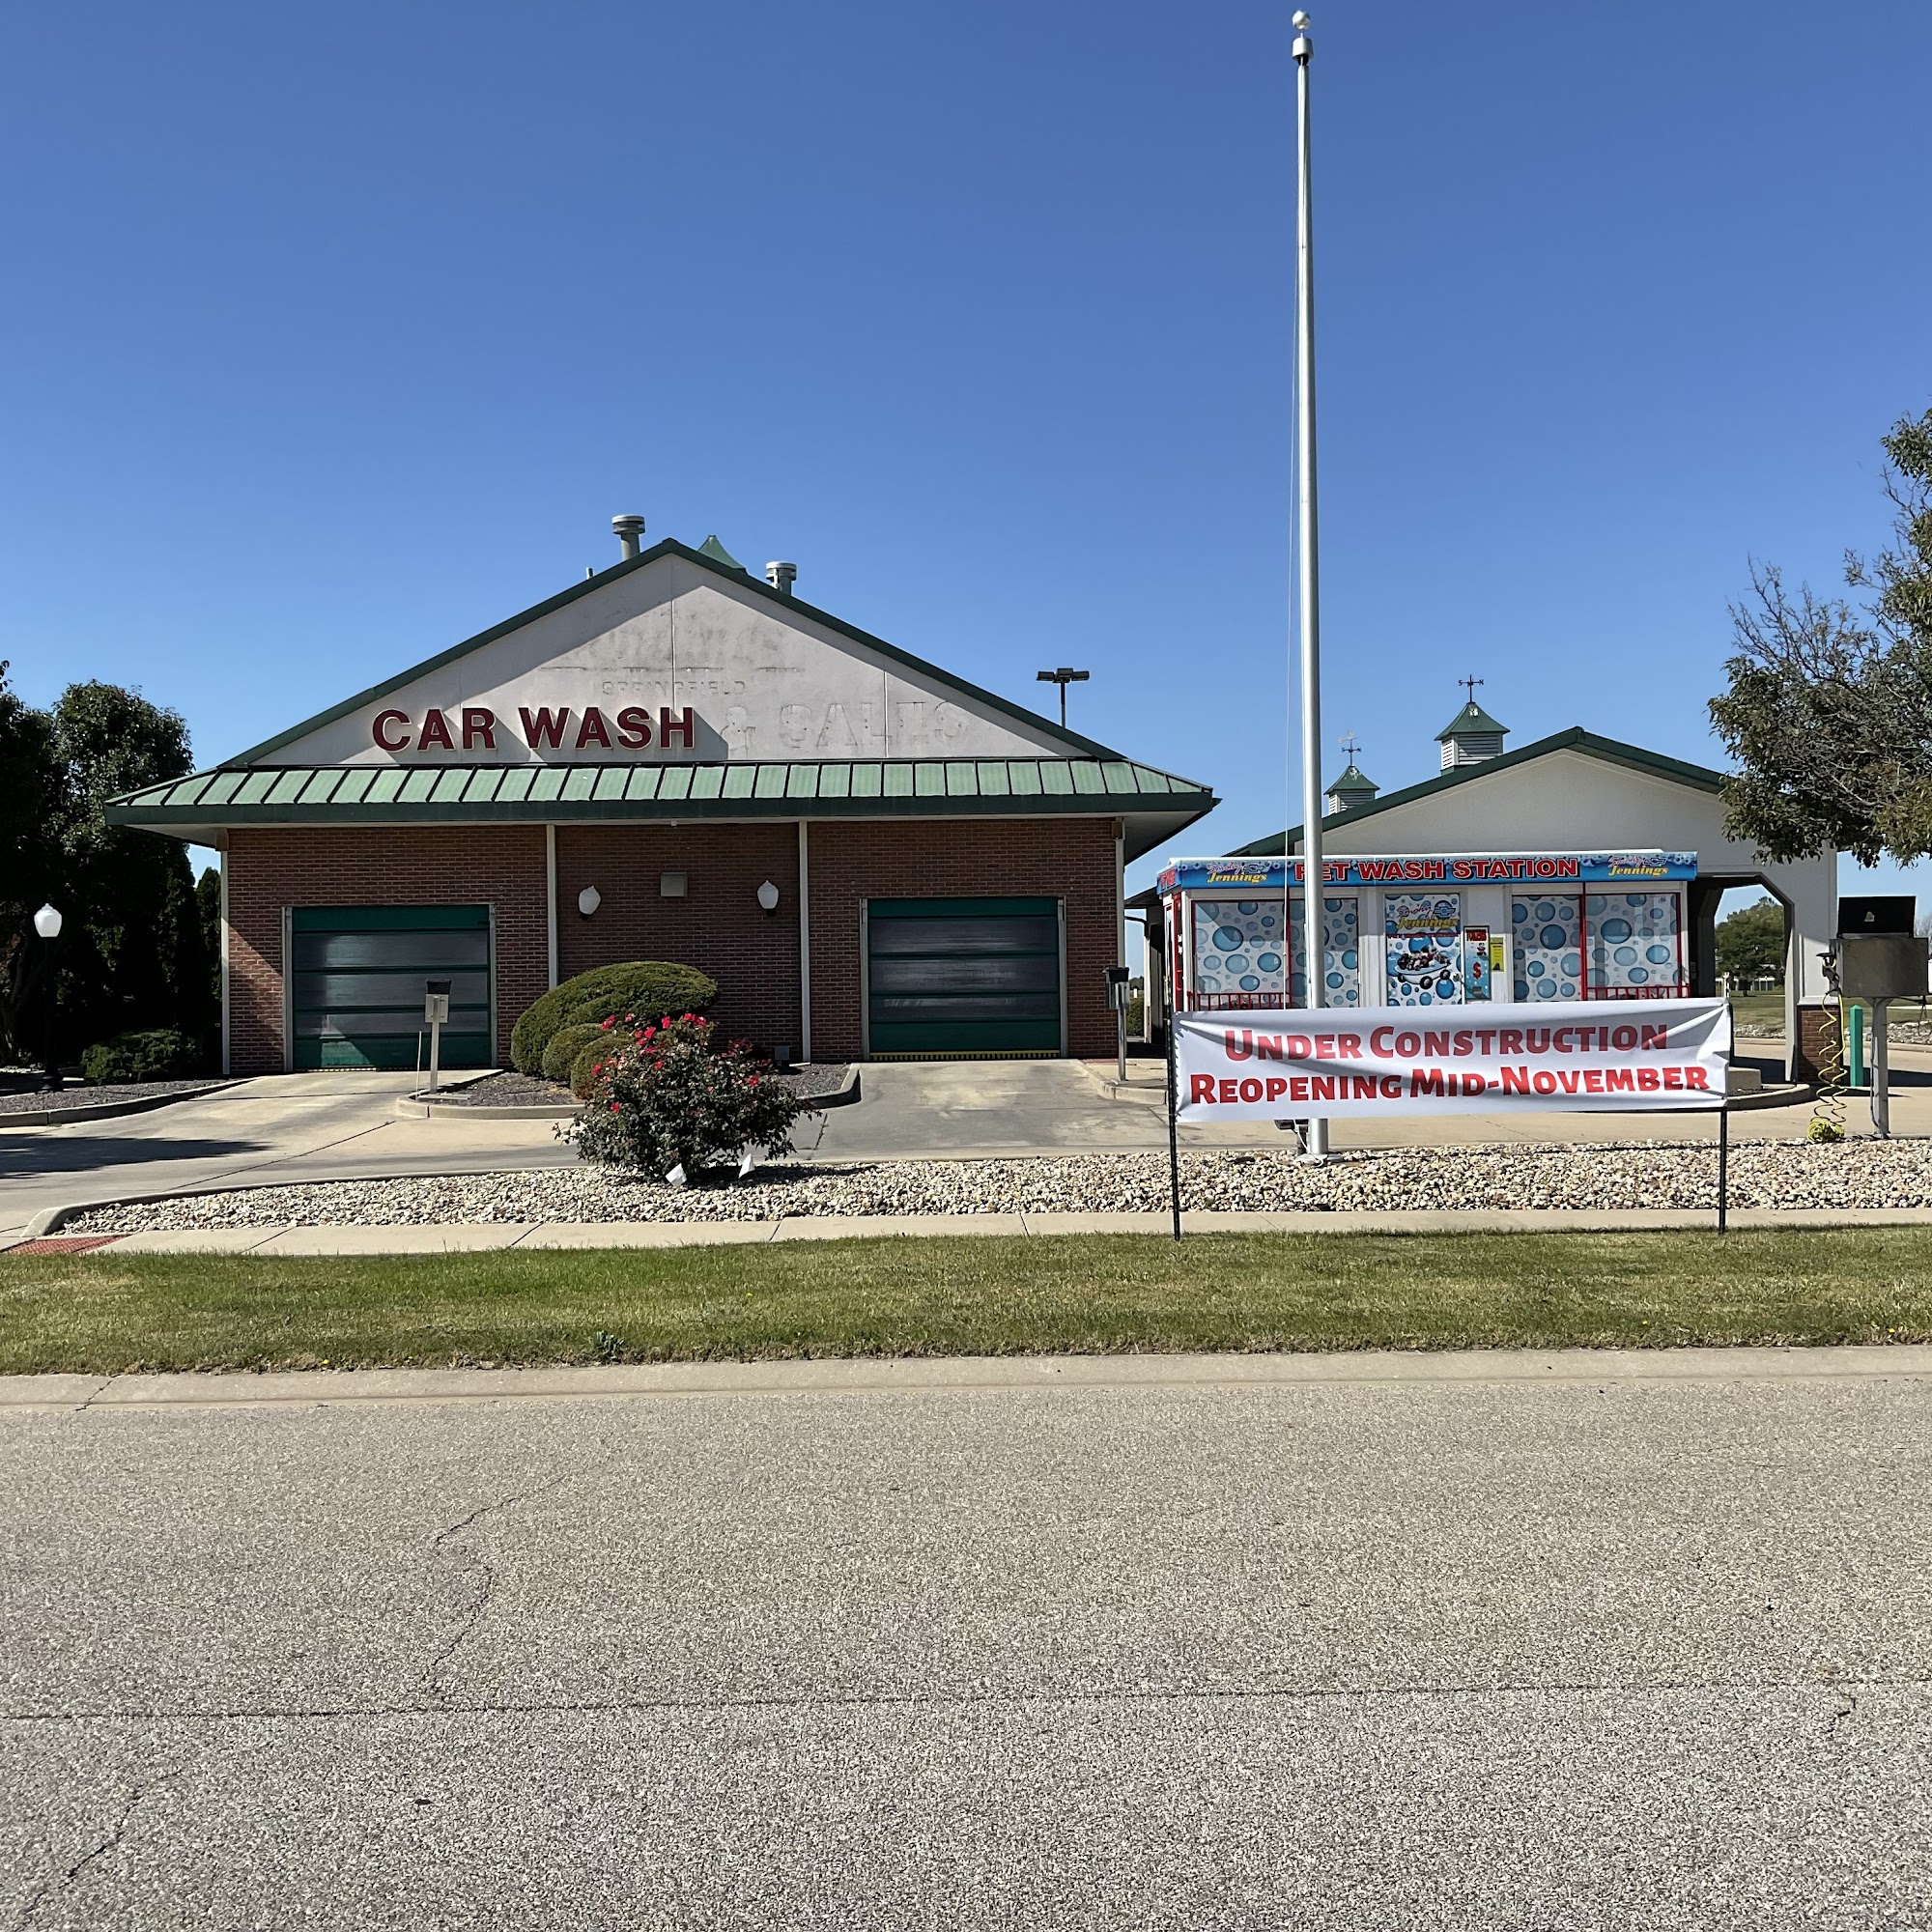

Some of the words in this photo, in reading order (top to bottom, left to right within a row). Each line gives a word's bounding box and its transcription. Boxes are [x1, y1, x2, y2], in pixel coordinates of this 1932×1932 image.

[372, 708, 497, 753] CAR
[518, 707, 695, 751] WASH
[1207, 872, 1267, 884] Jennings
[1358, 860, 1445, 881] WASH
[1453, 858, 1579, 879] STATION
[1608, 866, 1668, 877] Jennings
[1396, 917, 1459, 929] Jennings
[1224, 1029, 1363, 1062] UNDER
[1370, 1024, 1668, 1059] CONSTRUCTION
[1190, 1073, 1402, 1105] REOPENING
[1409, 1065, 1711, 1099] MID-NOVEMBER
